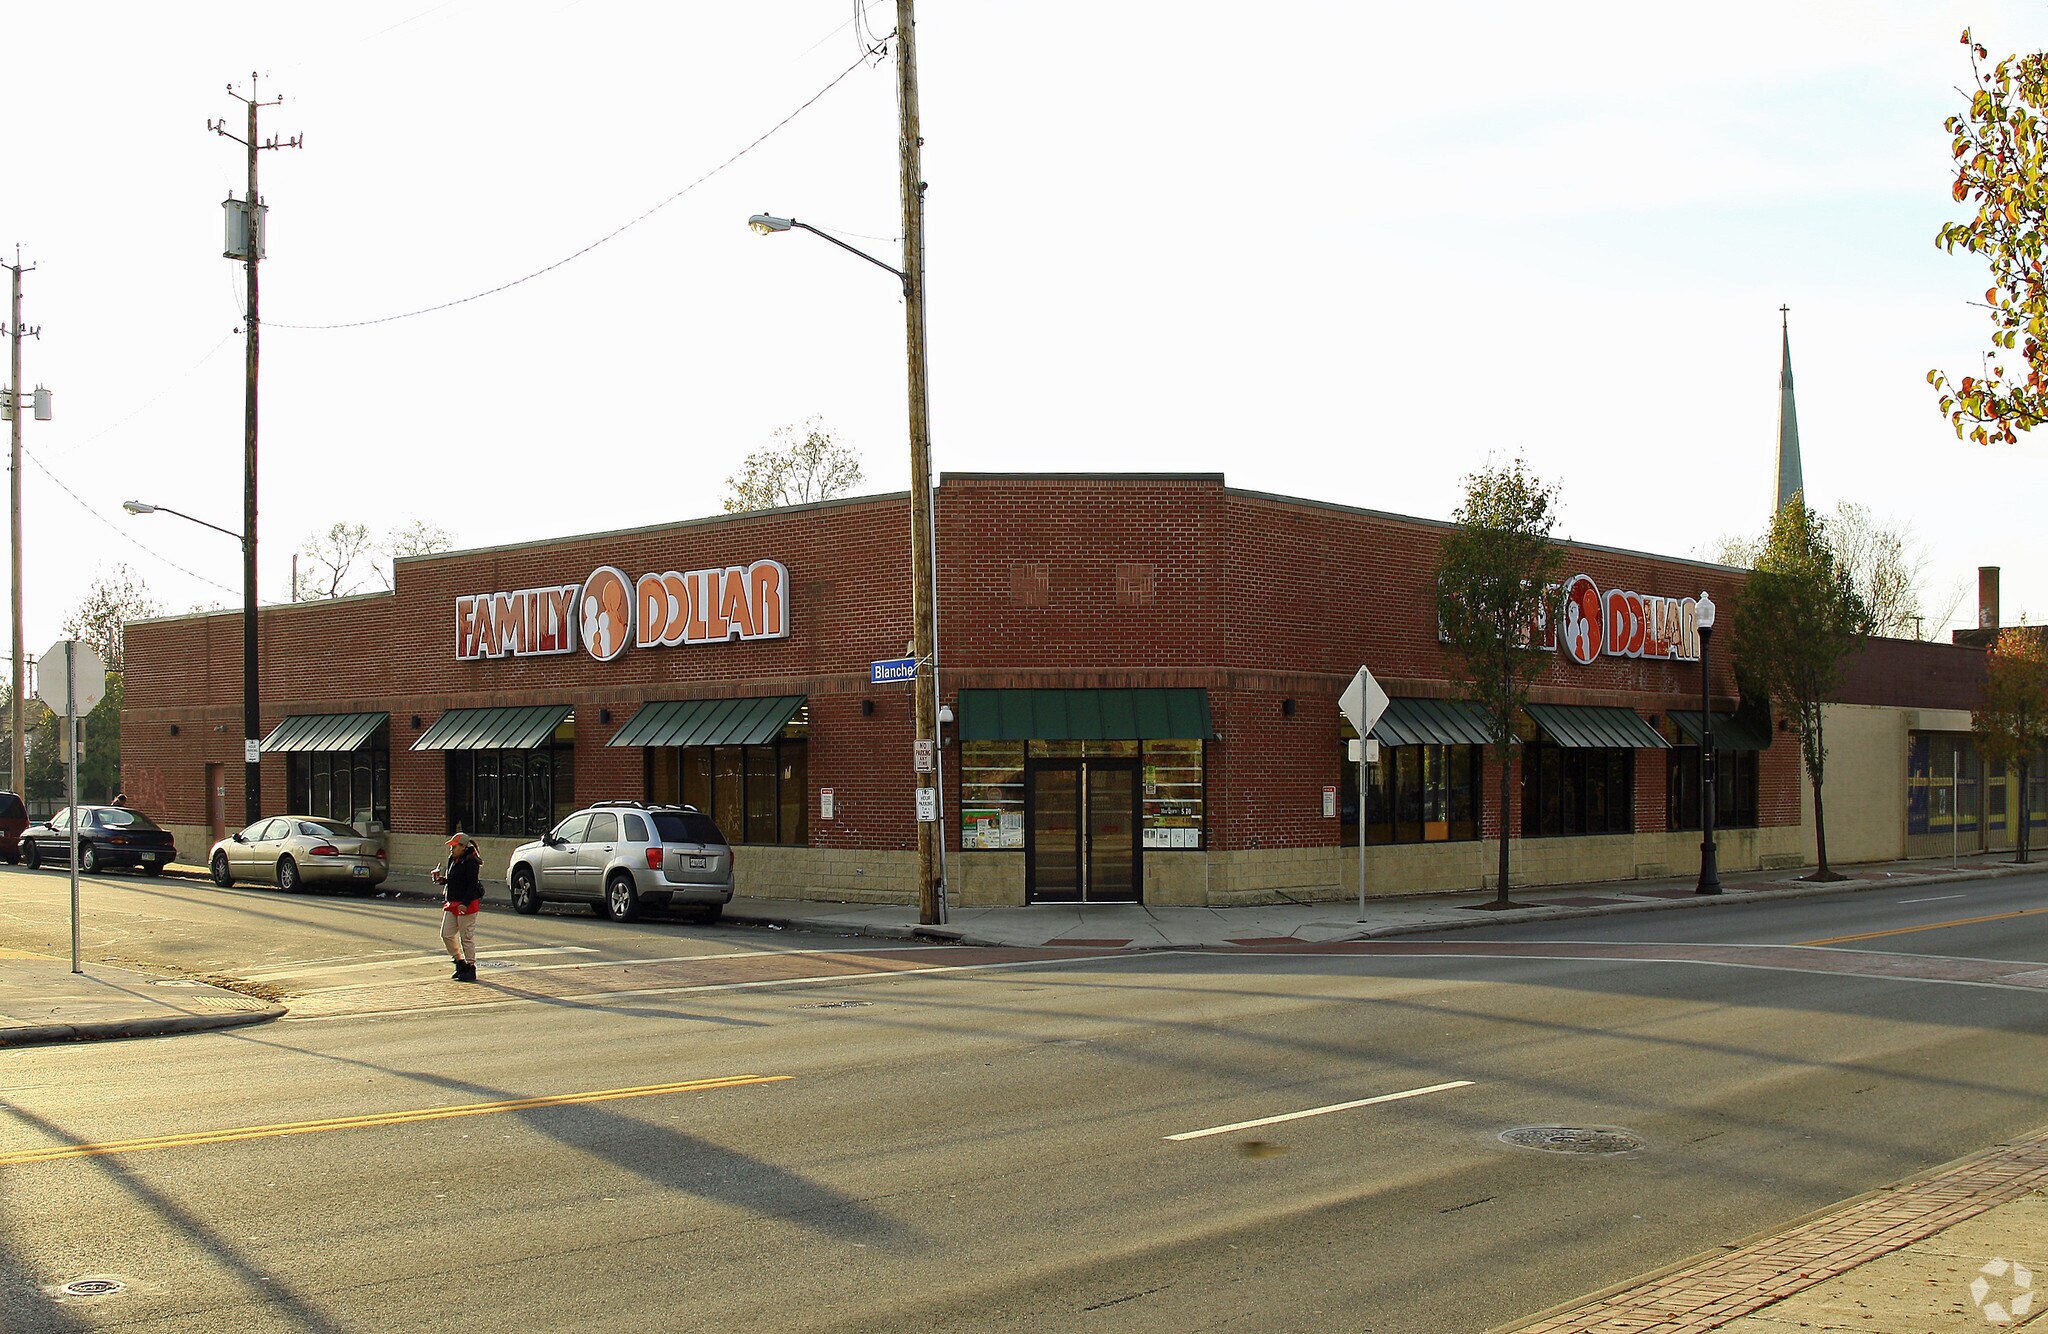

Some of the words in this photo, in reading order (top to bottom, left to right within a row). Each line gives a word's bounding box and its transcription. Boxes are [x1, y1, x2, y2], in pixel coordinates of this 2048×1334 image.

[456, 586, 578, 658] FAMILY
[637, 560, 783, 646] DOLLAR
[1604, 590, 1701, 660] DOLLAR
[875, 663, 914, 679] Blanche
[919, 742, 927, 750] NO
